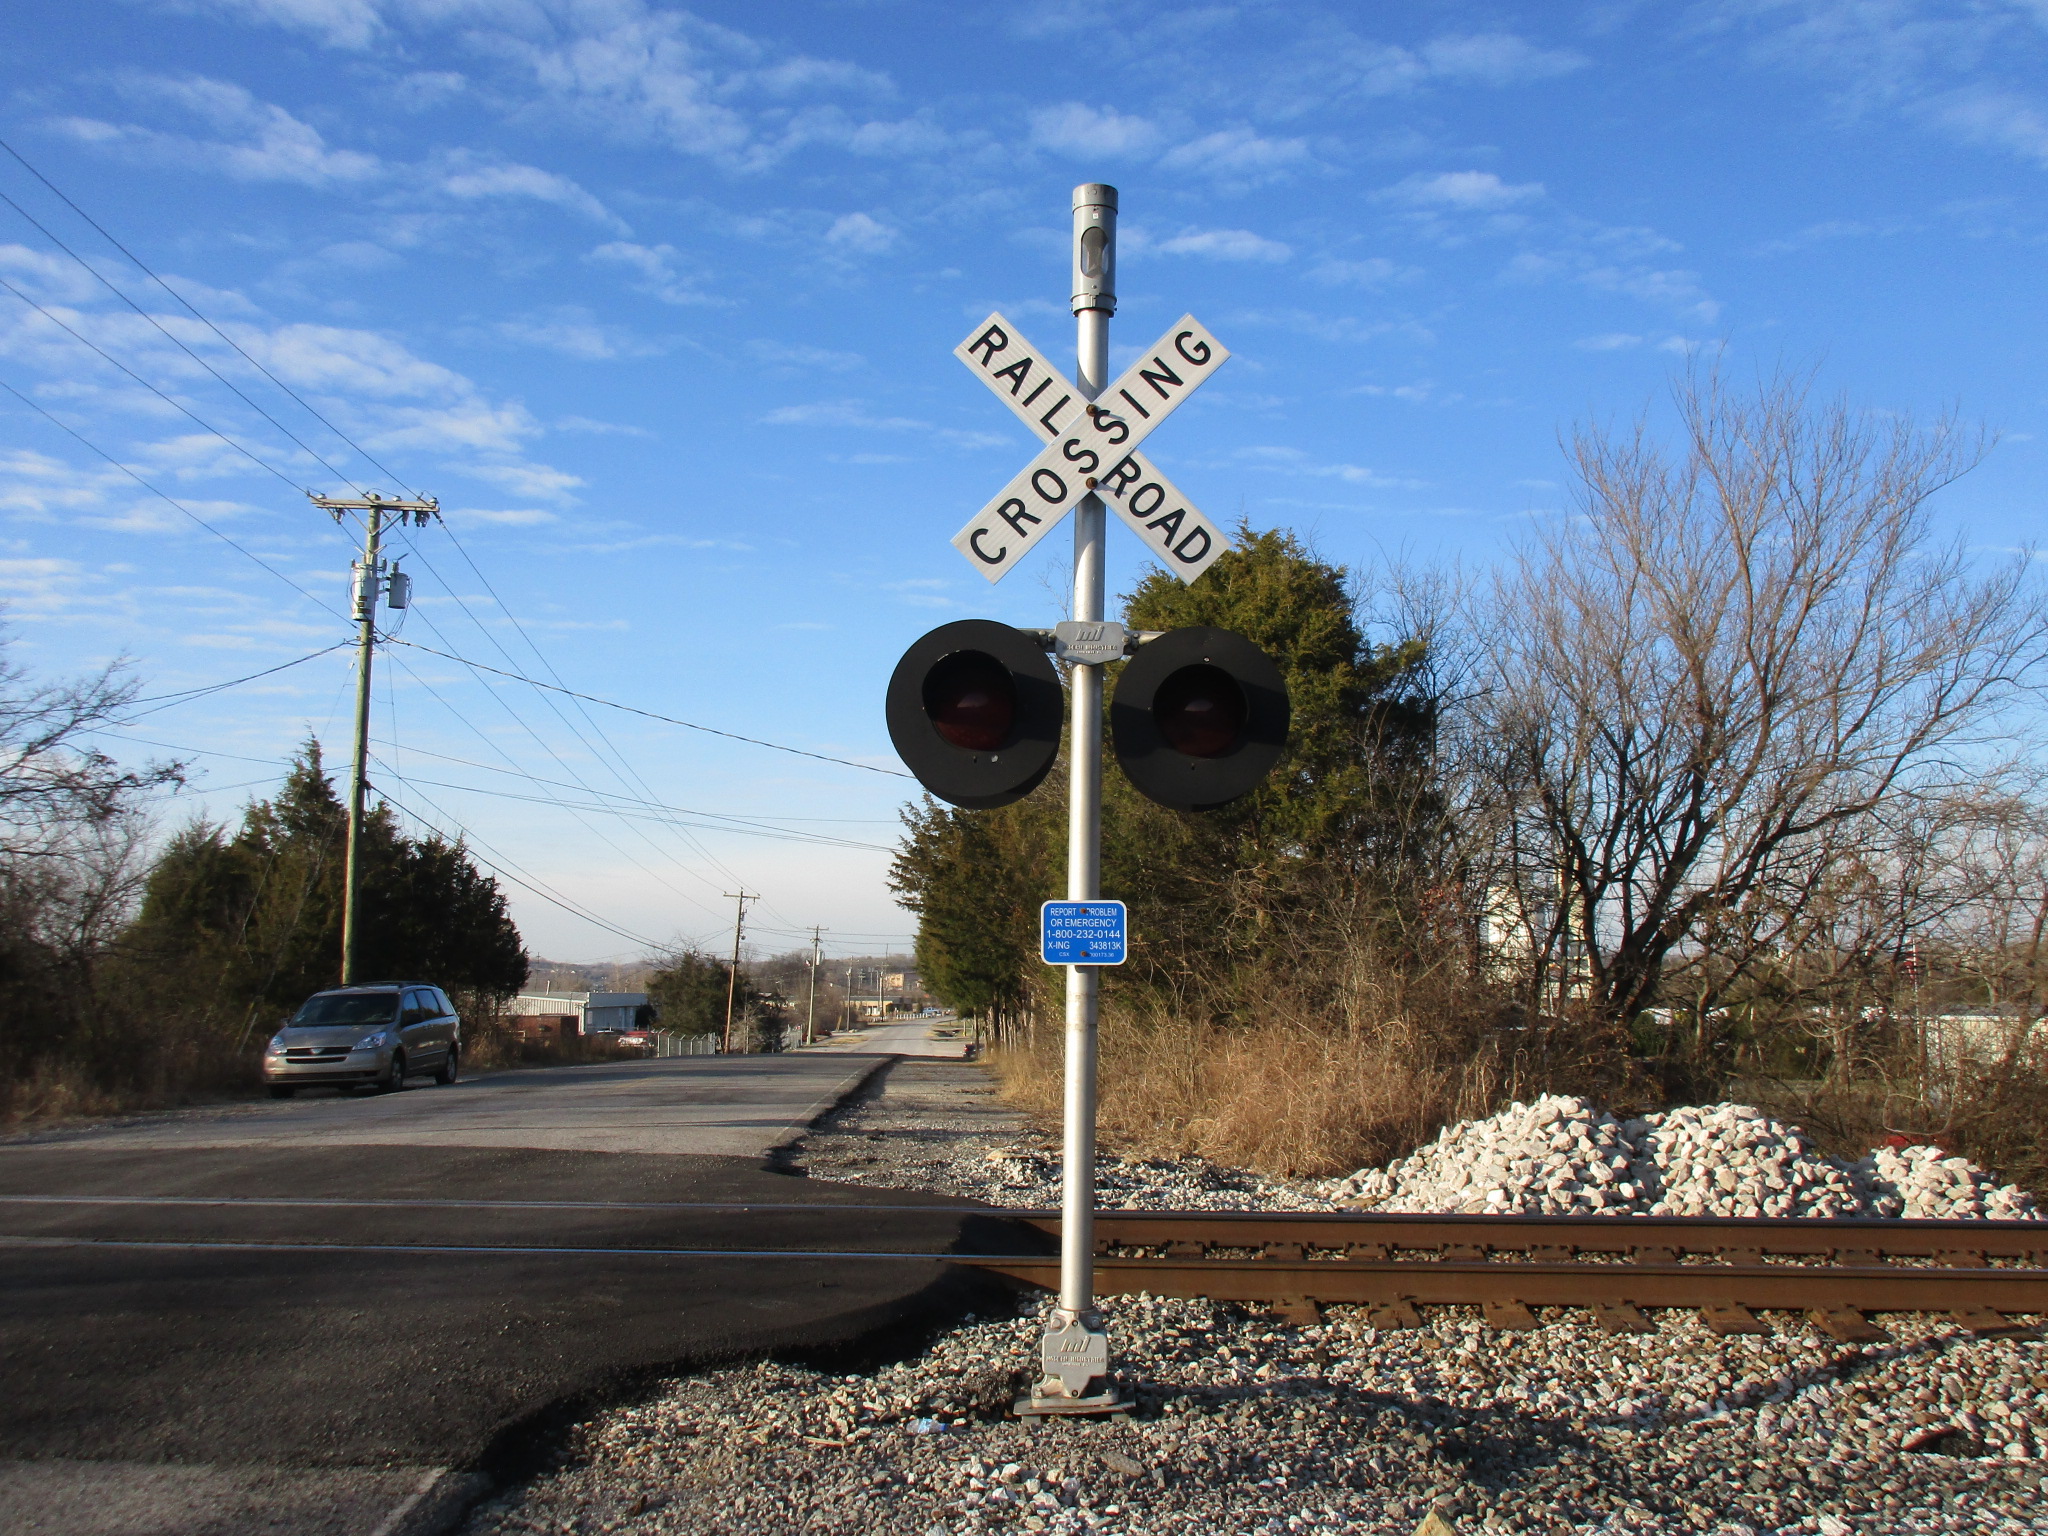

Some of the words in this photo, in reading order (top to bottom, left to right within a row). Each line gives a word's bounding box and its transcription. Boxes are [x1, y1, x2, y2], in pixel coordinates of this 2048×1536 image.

[970, 331, 1211, 564] CROSSING
[1050, 907, 1077, 916] REPORT
[1085, 907, 1117, 916] PROBLEM
[1050, 918, 1063, 927] OR
[1065, 918, 1117, 927] EMERGENCY
[1046, 929, 1121, 939] 1-800-232-0144
[1047, 941, 1070, 950] X-ING
[1089, 941, 1122, 950] 343813K
